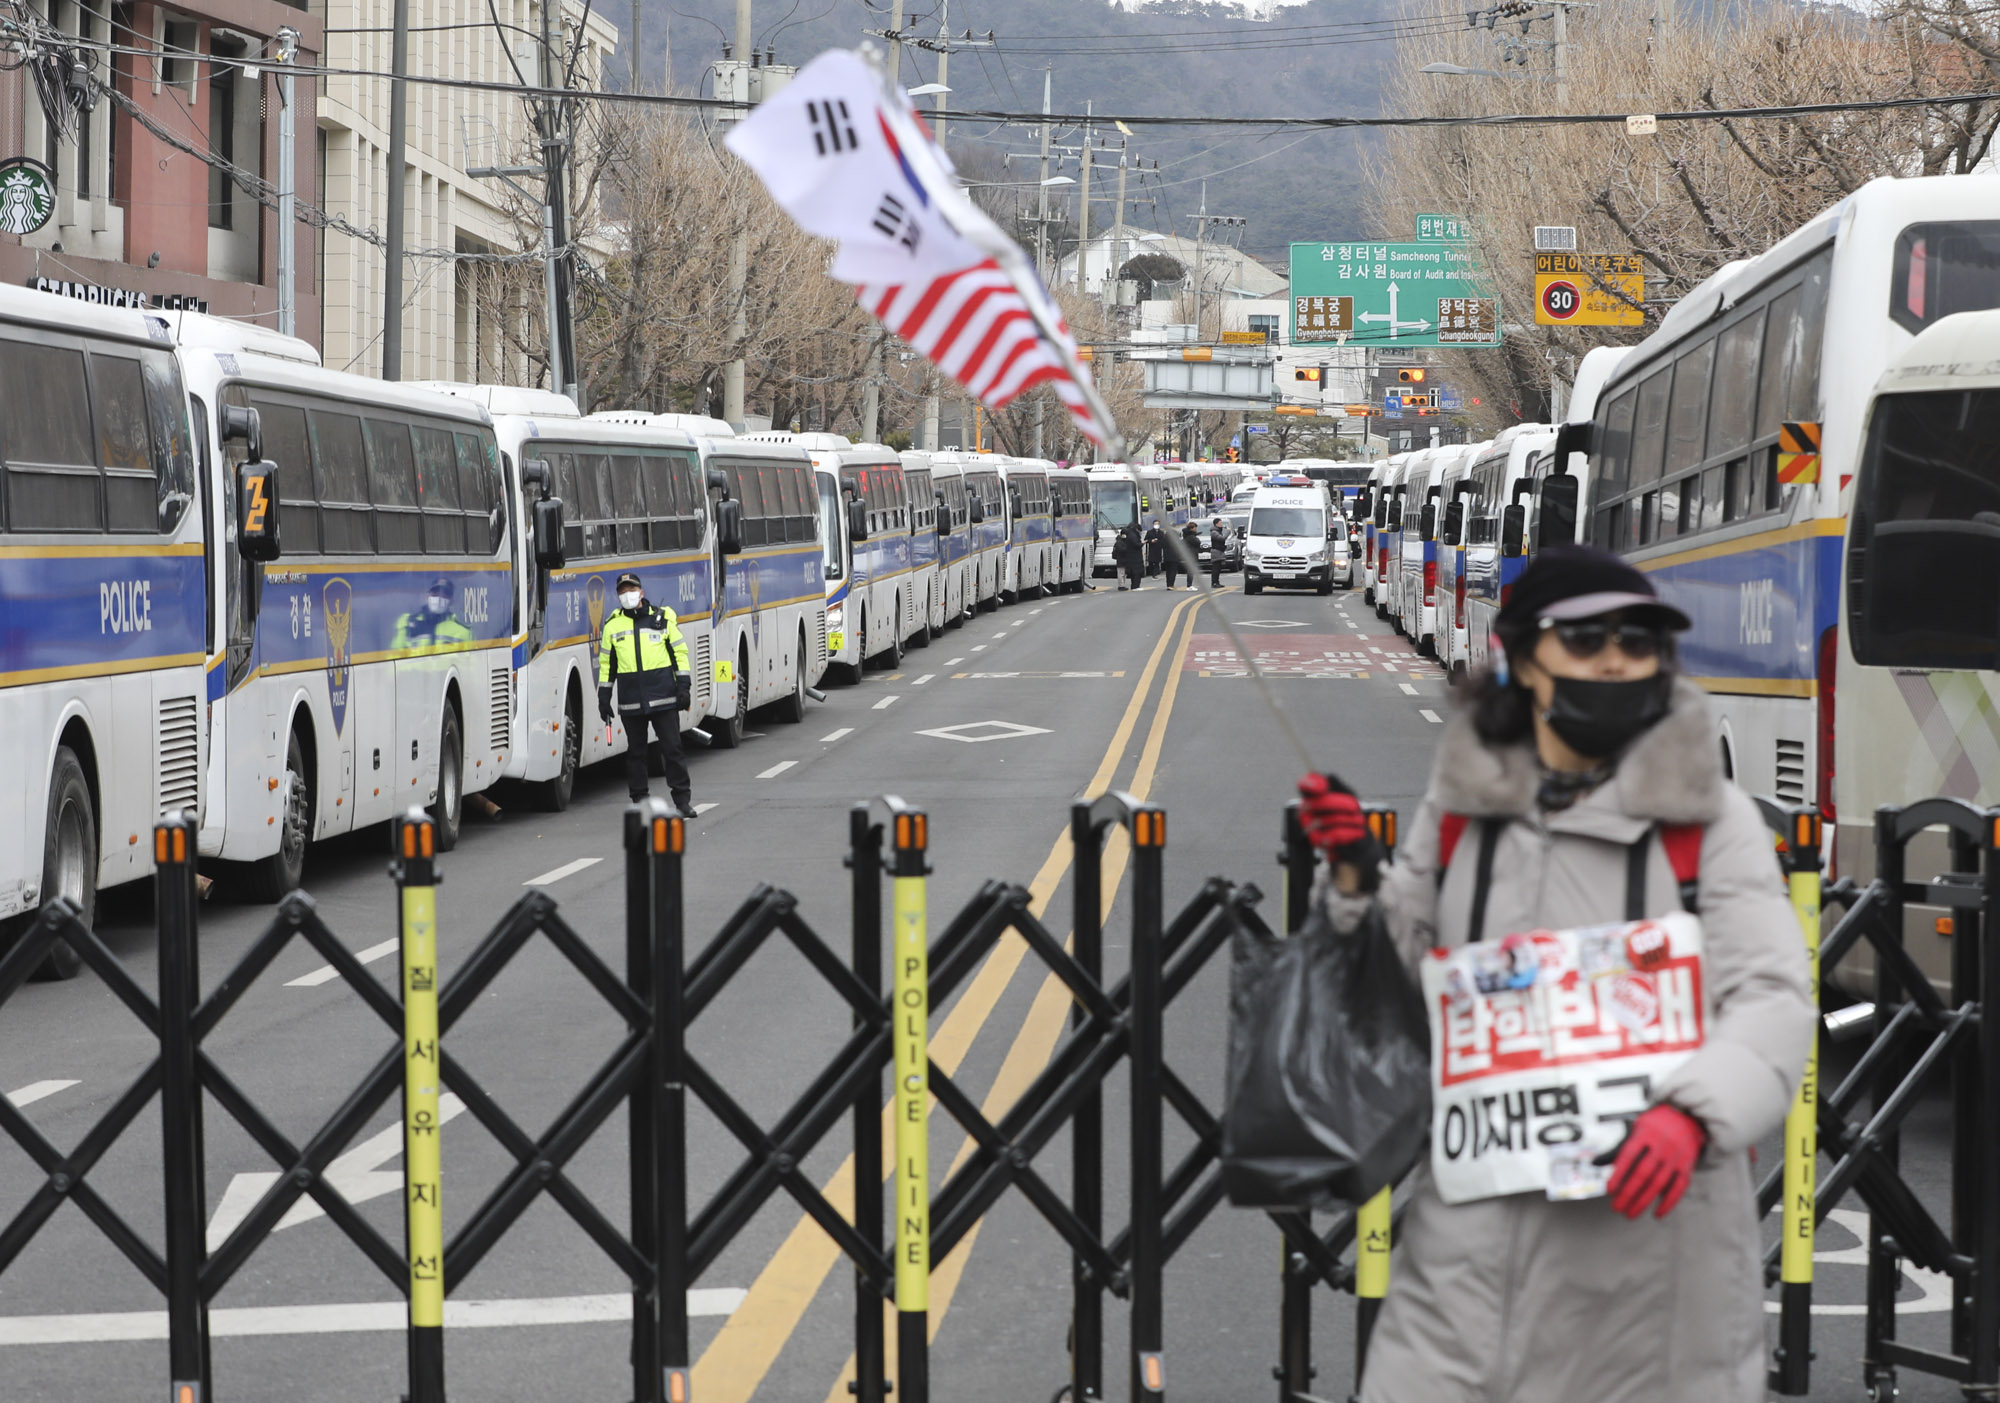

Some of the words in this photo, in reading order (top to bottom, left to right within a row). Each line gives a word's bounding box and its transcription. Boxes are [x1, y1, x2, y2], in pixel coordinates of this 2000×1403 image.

[1320, 245, 1387, 261] 삼청터널
[1390, 250, 1440, 263] Samcheong
[1338, 263, 1387, 279] 감사원
[1390, 269, 1412, 280] Board
[1413, 269, 1421, 279] of
[1425, 269, 1444, 280] Audit
[1297, 297, 1340, 313] 경복궁
[1440, 299, 1480, 315] 창덕궁
[1550, 291, 1572, 309] 30
[464, 587, 488, 623] POLICE
[678, 573, 696, 602] POLICE
[100, 579, 152, 634] POLICE
[1740, 578, 1772, 645] POLICE
[902, 958, 924, 1122] POLICE
[1445, 1084, 1583, 1169] 이재명
[1797, 1137, 1812, 1239] LINE
[905, 1158, 923, 1264] LINE
